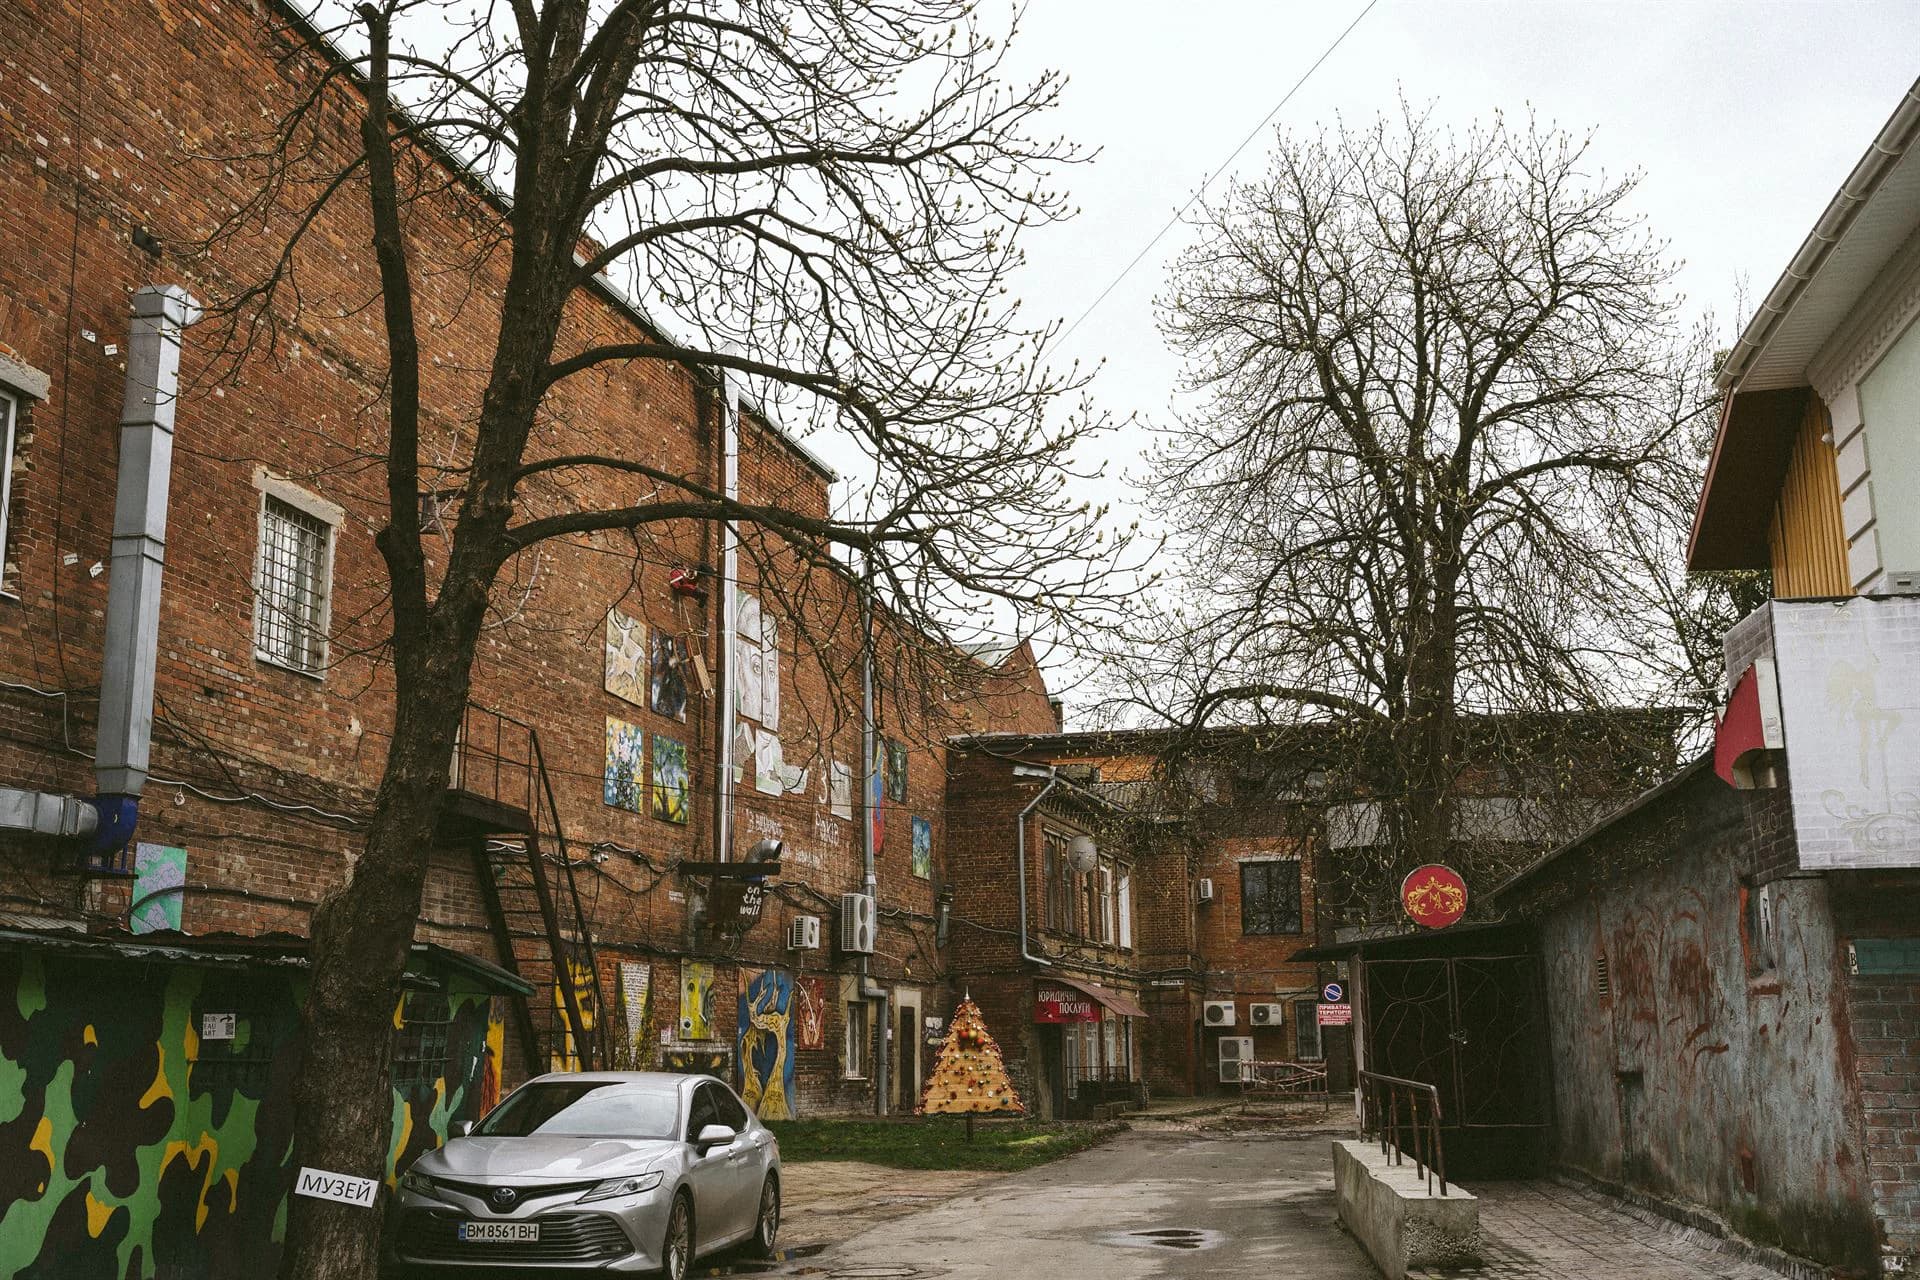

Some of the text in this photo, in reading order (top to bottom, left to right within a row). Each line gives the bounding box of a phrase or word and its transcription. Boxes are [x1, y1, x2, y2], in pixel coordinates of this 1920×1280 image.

[747, 886, 760, 895] on
[742, 893, 762, 905] the
[739, 905, 760, 915] wall
[1038, 991, 1077, 1002] ЮРИДИЧНІ
[1059, 1002, 1091, 1014] ПОСЛУГИ
[302, 1174, 371, 1202] МУЗЕЙ
[467, 1224, 537, 1239] BM 8561 BH
